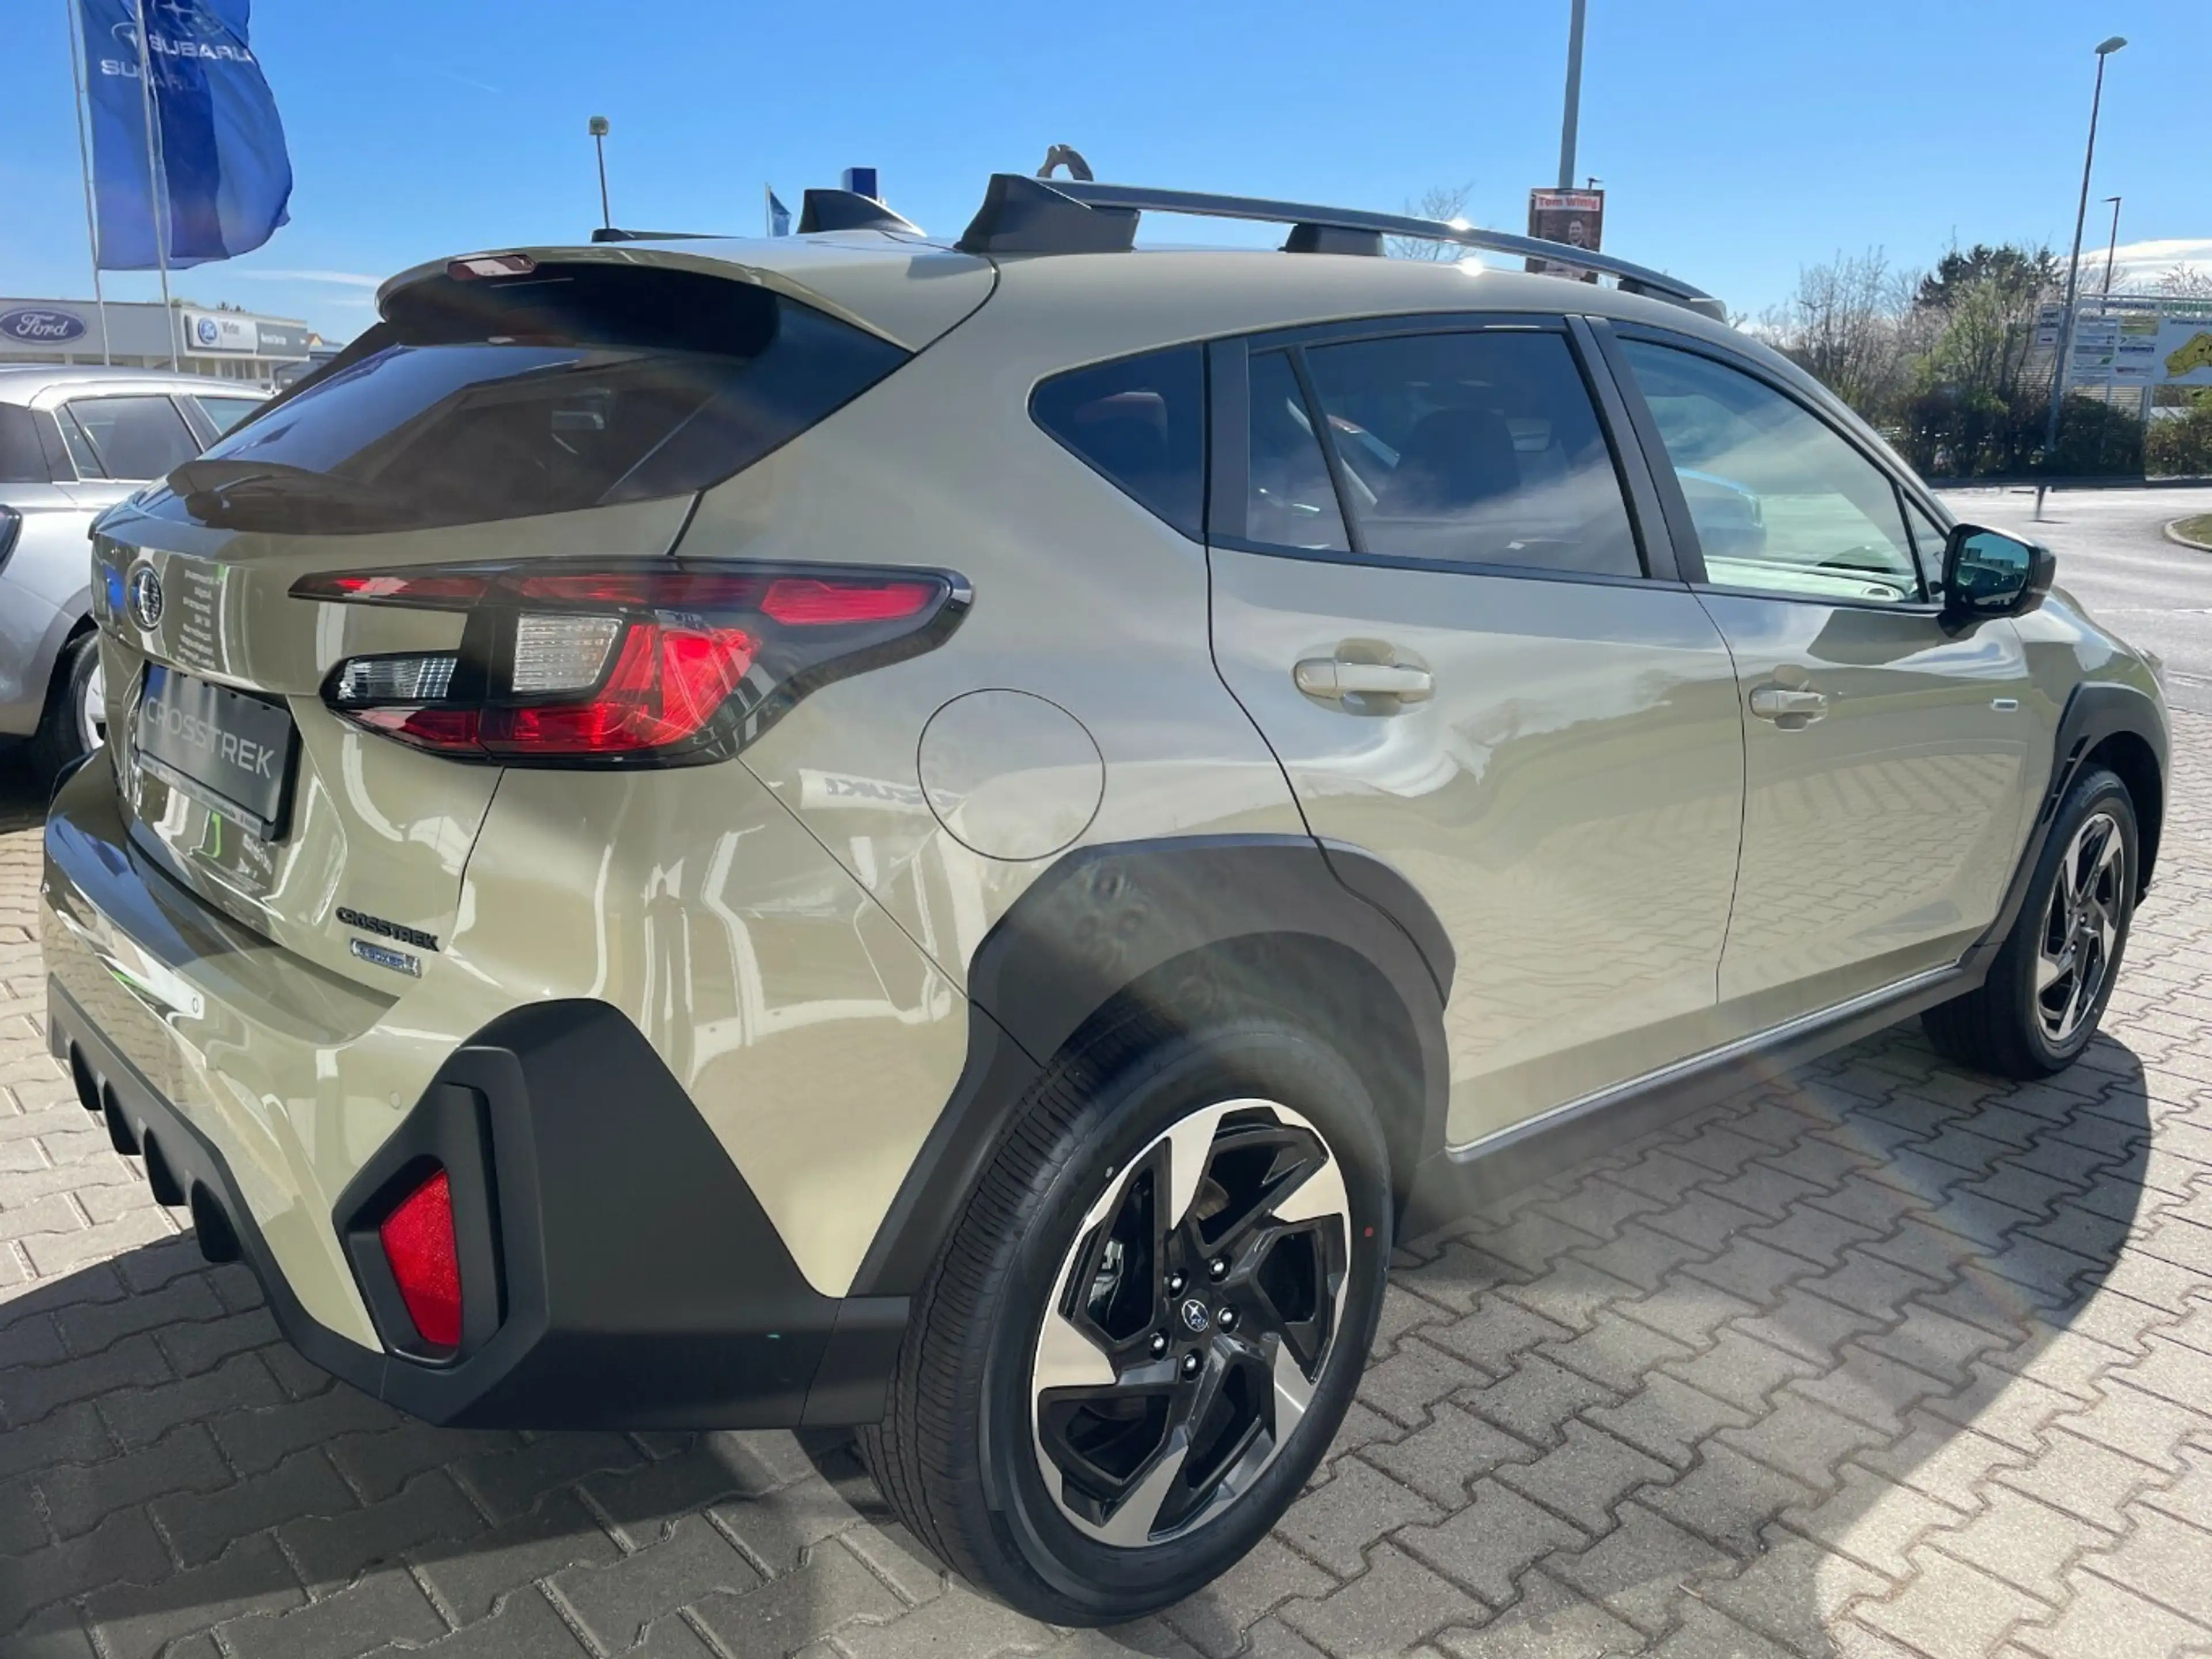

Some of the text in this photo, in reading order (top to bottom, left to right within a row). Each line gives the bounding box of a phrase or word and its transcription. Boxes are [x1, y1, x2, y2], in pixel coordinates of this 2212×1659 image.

[149, 34, 254, 62] SUBARU
[16, 314, 69, 336] Ford
[146, 696, 275, 779] CROSSTREK
[335, 906, 440, 952] CROSSTREK
